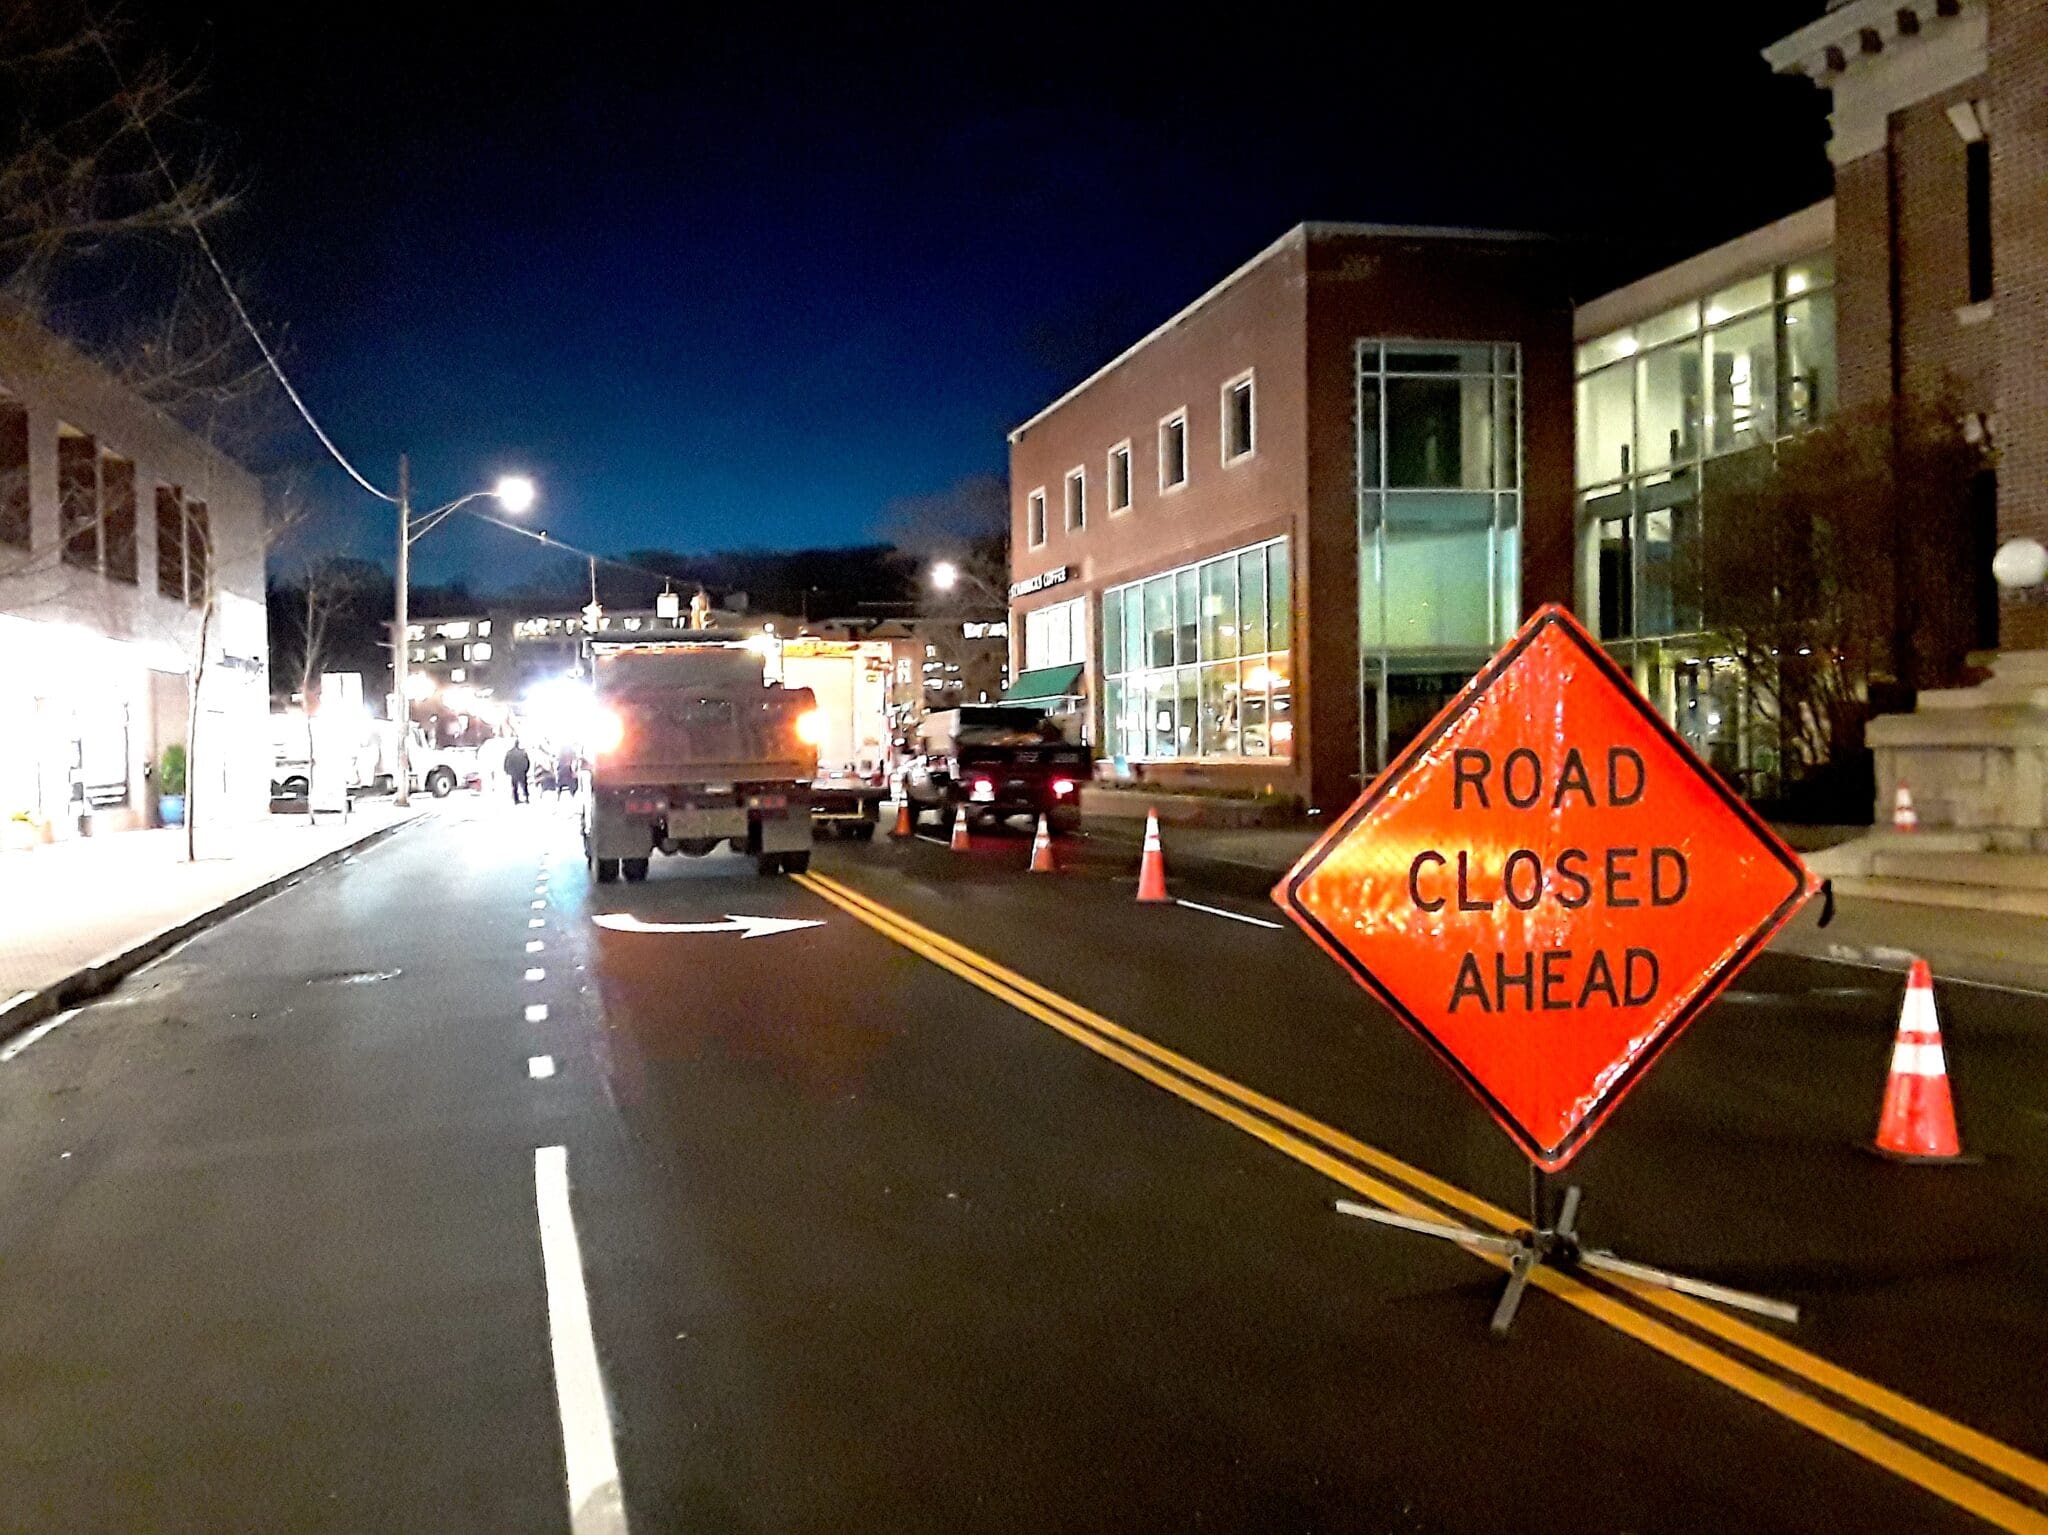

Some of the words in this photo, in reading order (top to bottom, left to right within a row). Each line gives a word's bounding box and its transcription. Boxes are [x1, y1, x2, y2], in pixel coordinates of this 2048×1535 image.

[1453, 747, 1646, 810] ROAD
[1408, 847, 1689, 913] CLOSED
[1447, 947, 1660, 1014] AHEAD
